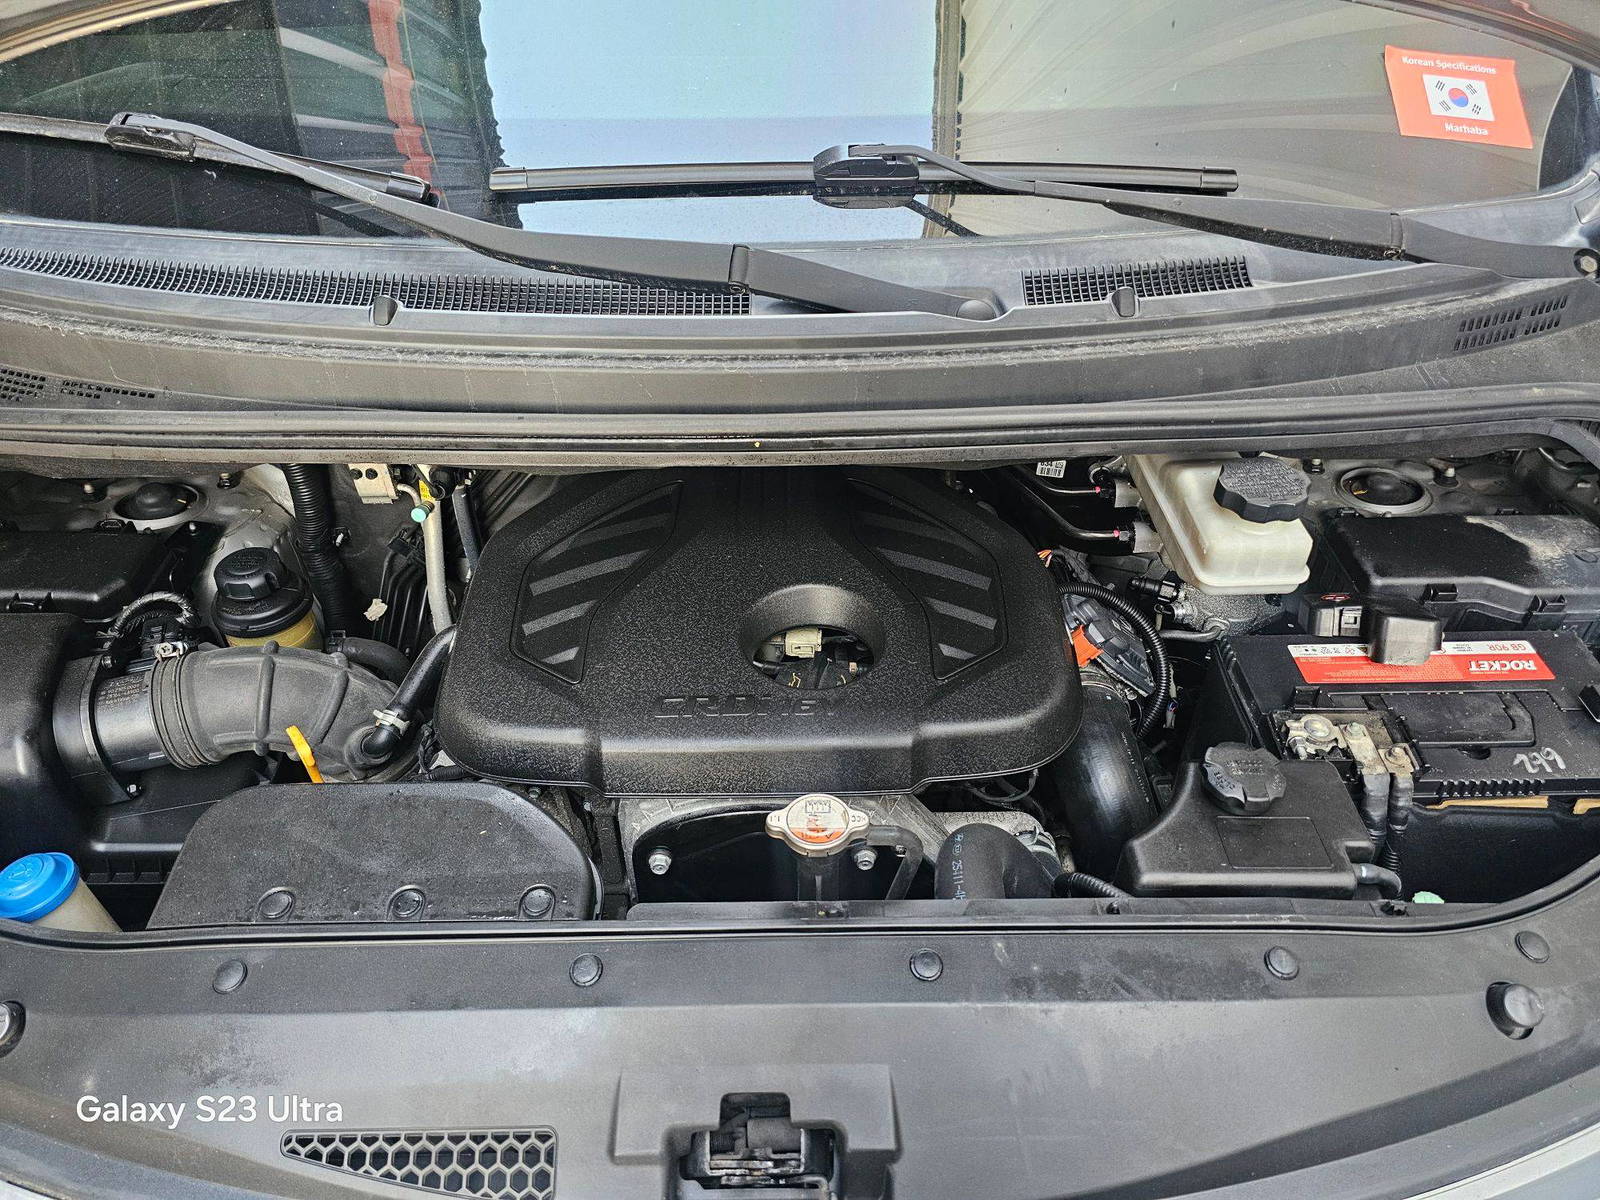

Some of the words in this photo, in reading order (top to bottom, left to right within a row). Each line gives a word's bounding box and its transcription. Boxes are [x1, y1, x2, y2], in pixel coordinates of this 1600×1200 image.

[1402, 56, 1434, 68] Korean
[1435, 60, 1497, 75] Specifications
[1444, 122, 1489, 136] Marhaba
[1469, 660, 1537, 671] ROCKET
